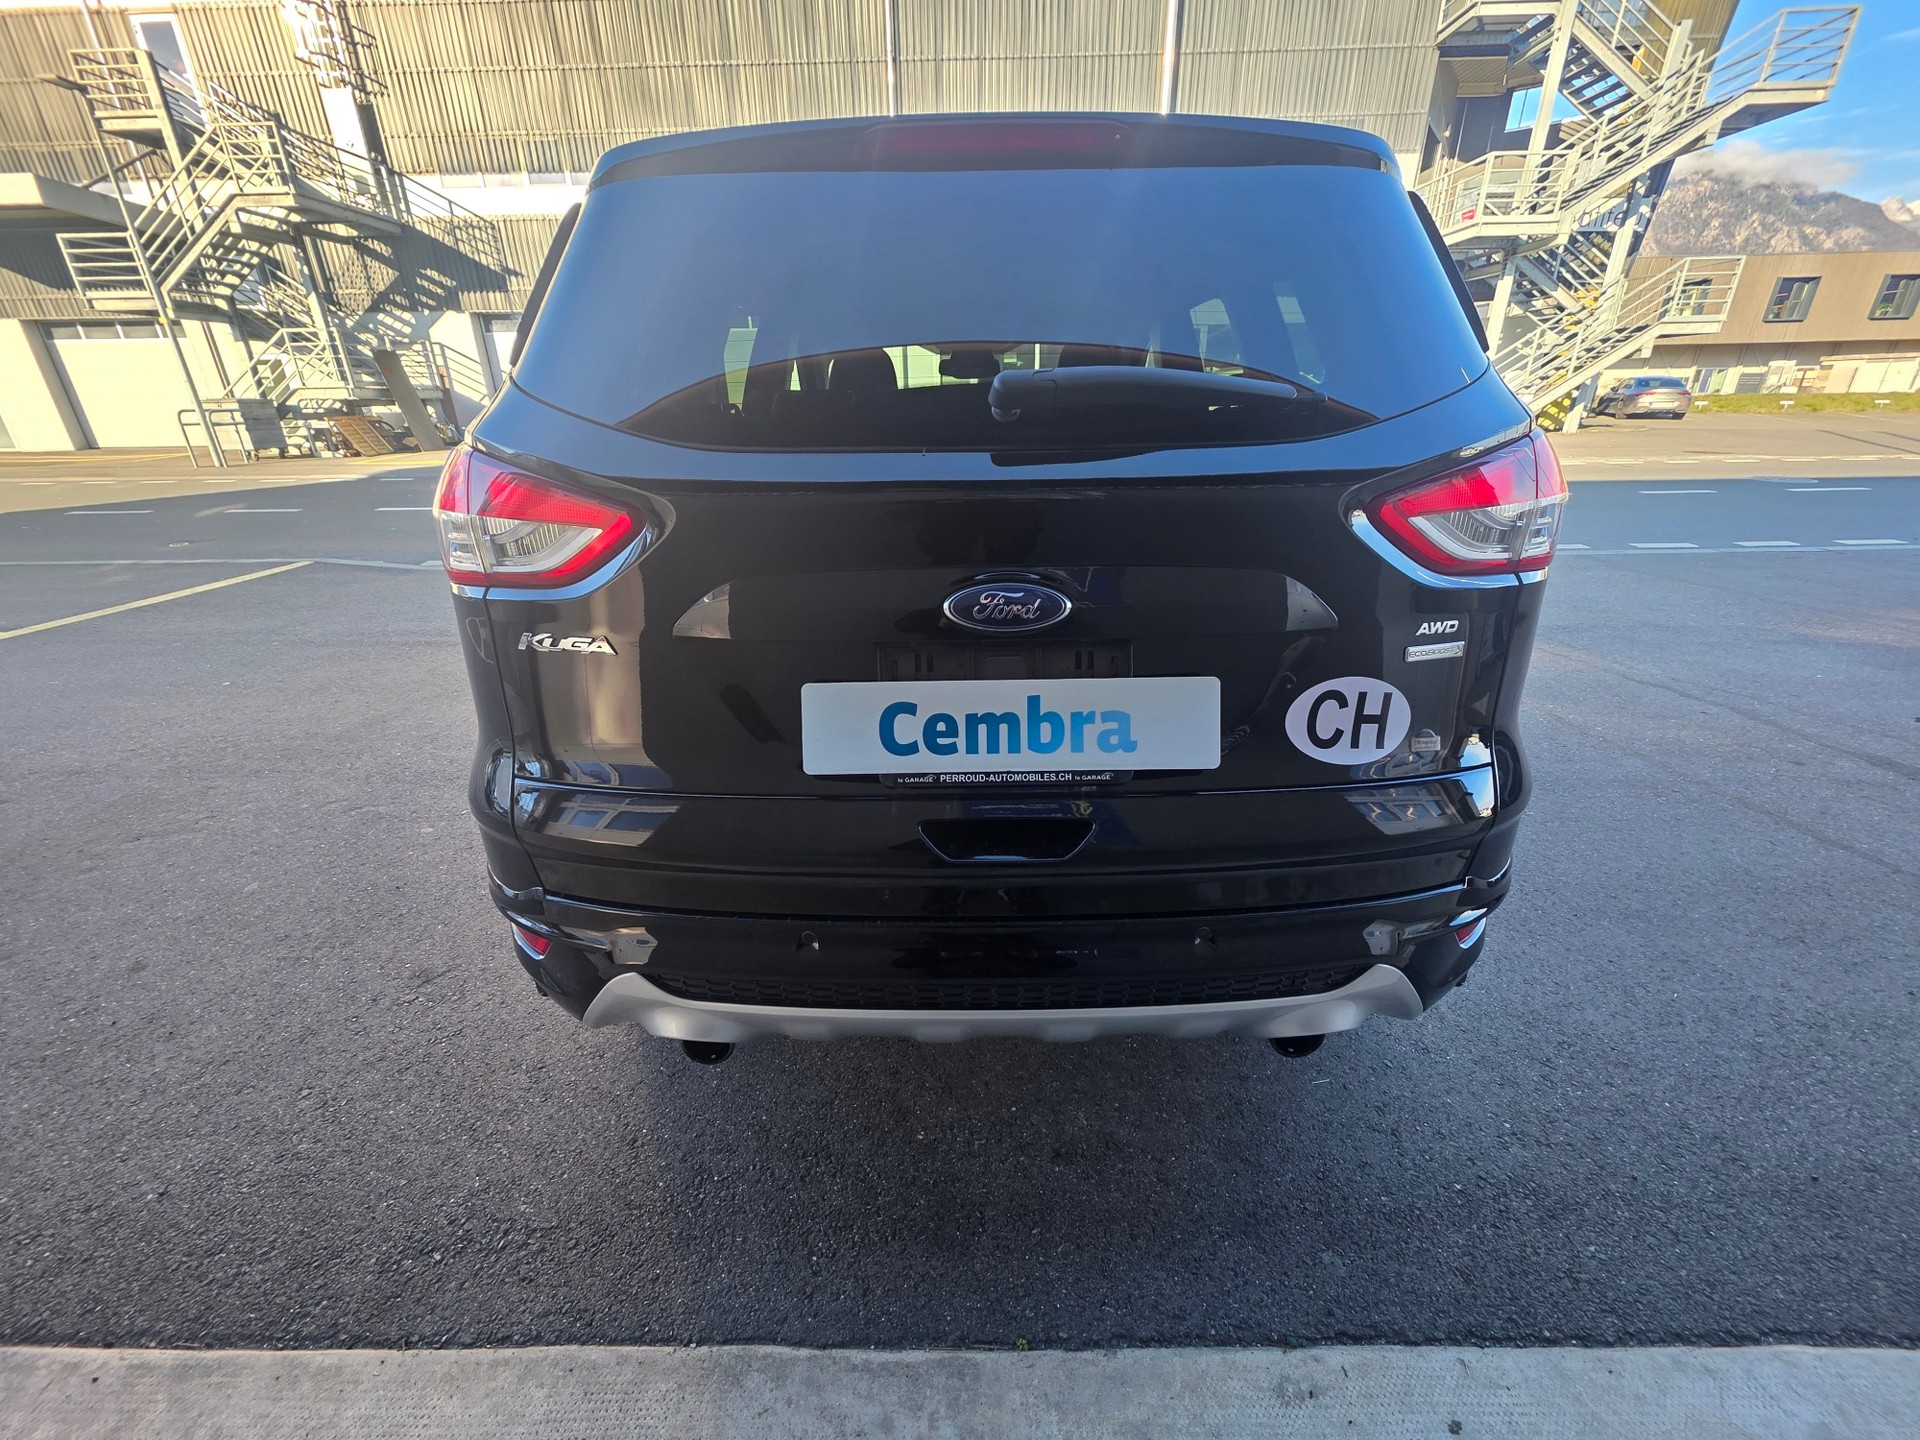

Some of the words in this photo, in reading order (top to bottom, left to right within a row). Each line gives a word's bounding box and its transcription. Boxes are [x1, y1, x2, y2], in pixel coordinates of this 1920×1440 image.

[972, 591, 1041, 620] Ford
[1415, 619, 1459, 636] AWD
[518, 632, 618, 656] KUGA
[1408, 646, 1458, 659] ECOBOOST
[878, 694, 1138, 757] Cembra
[1306, 689, 1394, 750] CH
[904, 776, 934, 784] GARAGE
[939, 772, 1073, 784] PERROUD-AUTOMOBILES.CH
[1081, 773, 1112, 781] GARAGE
